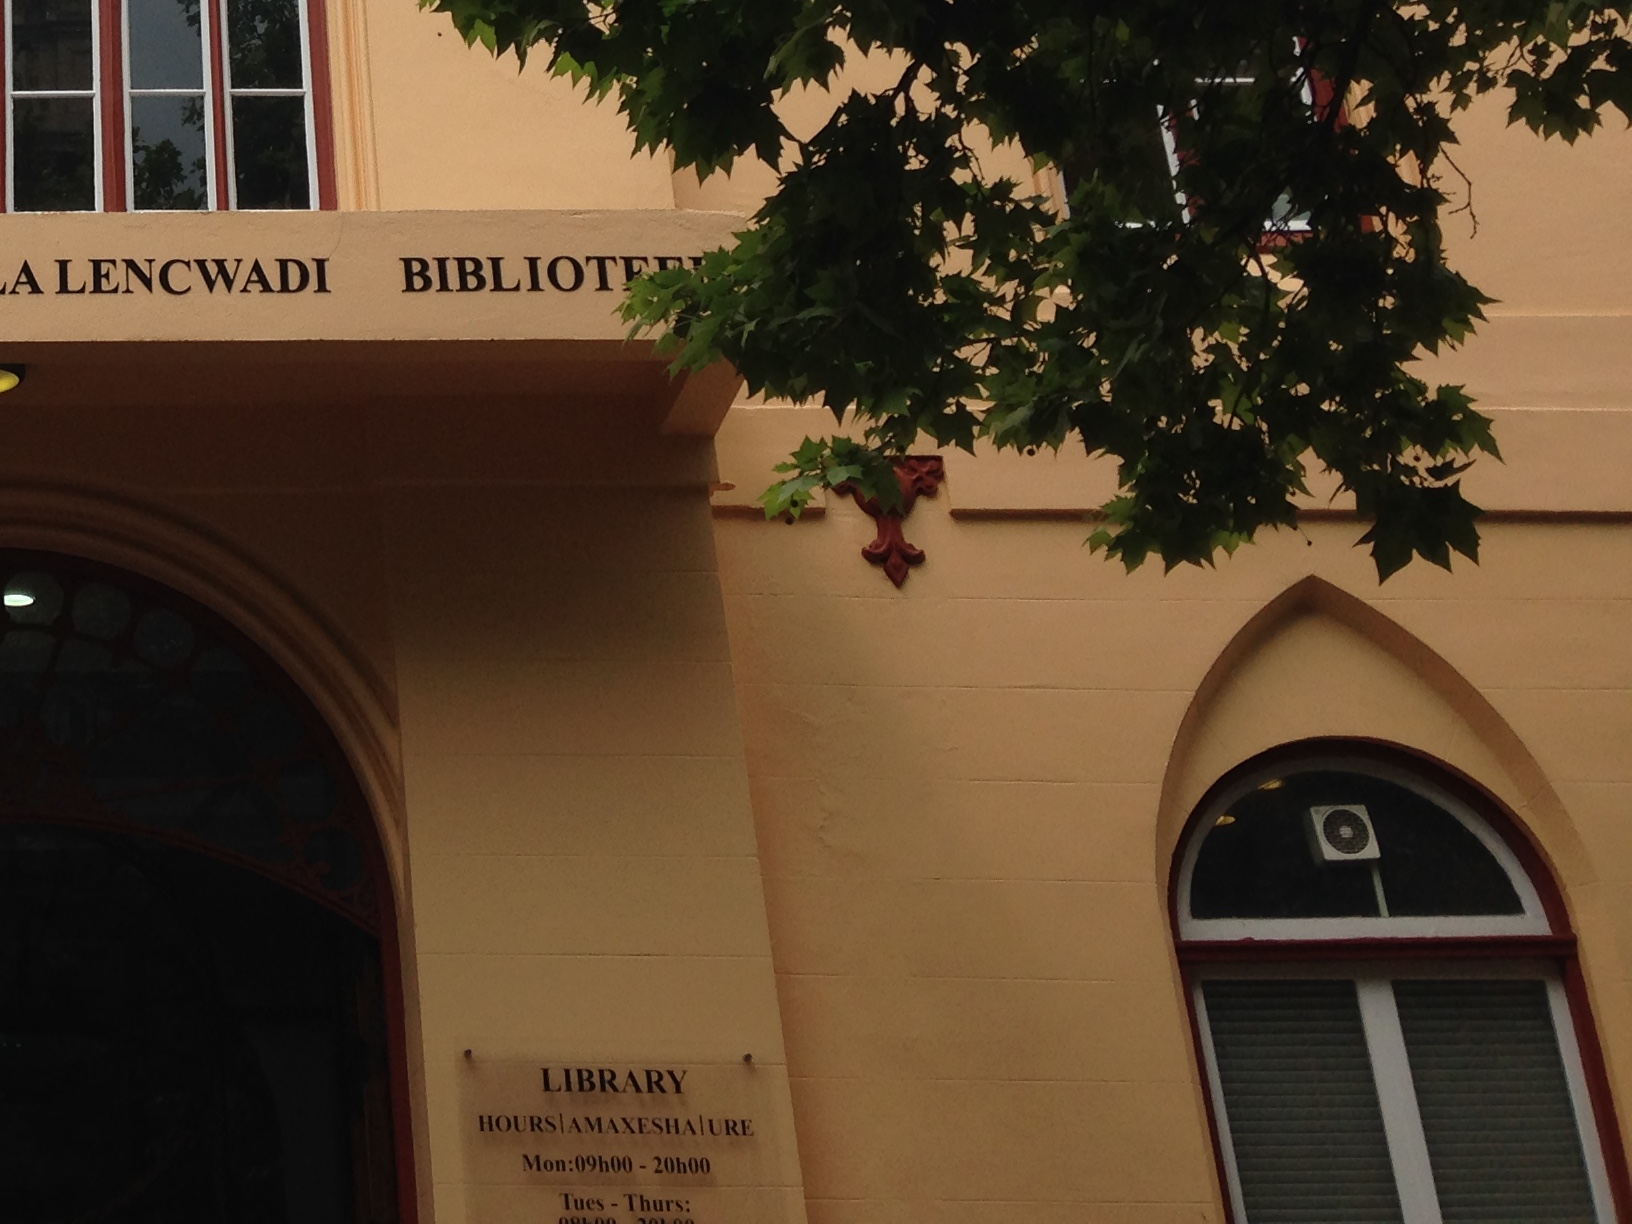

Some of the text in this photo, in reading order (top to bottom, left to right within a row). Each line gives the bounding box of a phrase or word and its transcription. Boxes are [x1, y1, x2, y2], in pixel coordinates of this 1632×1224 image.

[54, 258, 333, 295] LENCWADI
[540, 1067, 688, 1095] LIBRARY
[653, 1155, 712, 1176] 20h00
[558, 1192, 605, 1211] Tues
[623, 1193, 691, 1213] Thurs:
